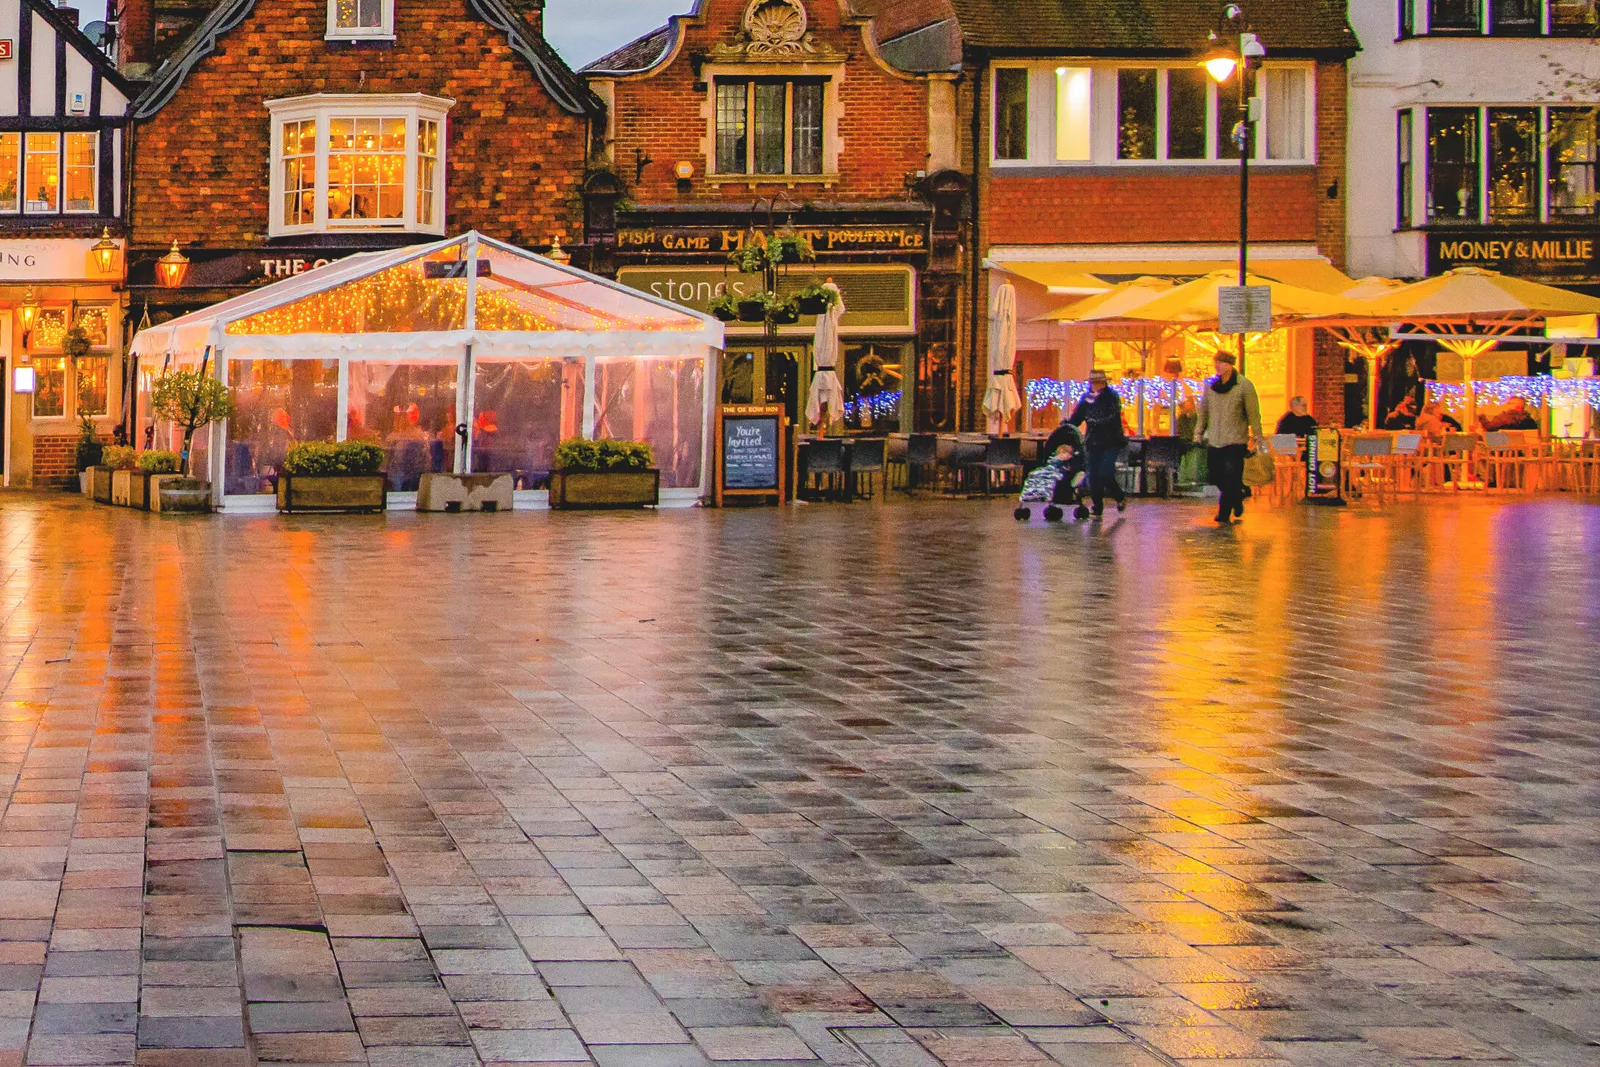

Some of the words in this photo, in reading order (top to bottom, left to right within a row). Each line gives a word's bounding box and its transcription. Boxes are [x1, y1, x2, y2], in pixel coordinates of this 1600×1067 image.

[618, 228, 656, 247] FISH
[662, 234, 710, 249] GAME
[720, 229, 821, 252] HAT
[828, 230, 894, 248] POULTRY
[899, 229, 924, 247] ICE
[1439, 240, 1512, 260] MONEY
[1514, 242, 1529, 258] &
[1532, 239, 1593, 259] MILLIE
[260, 259, 306, 278] THE
[650, 278, 745, 301] stones
